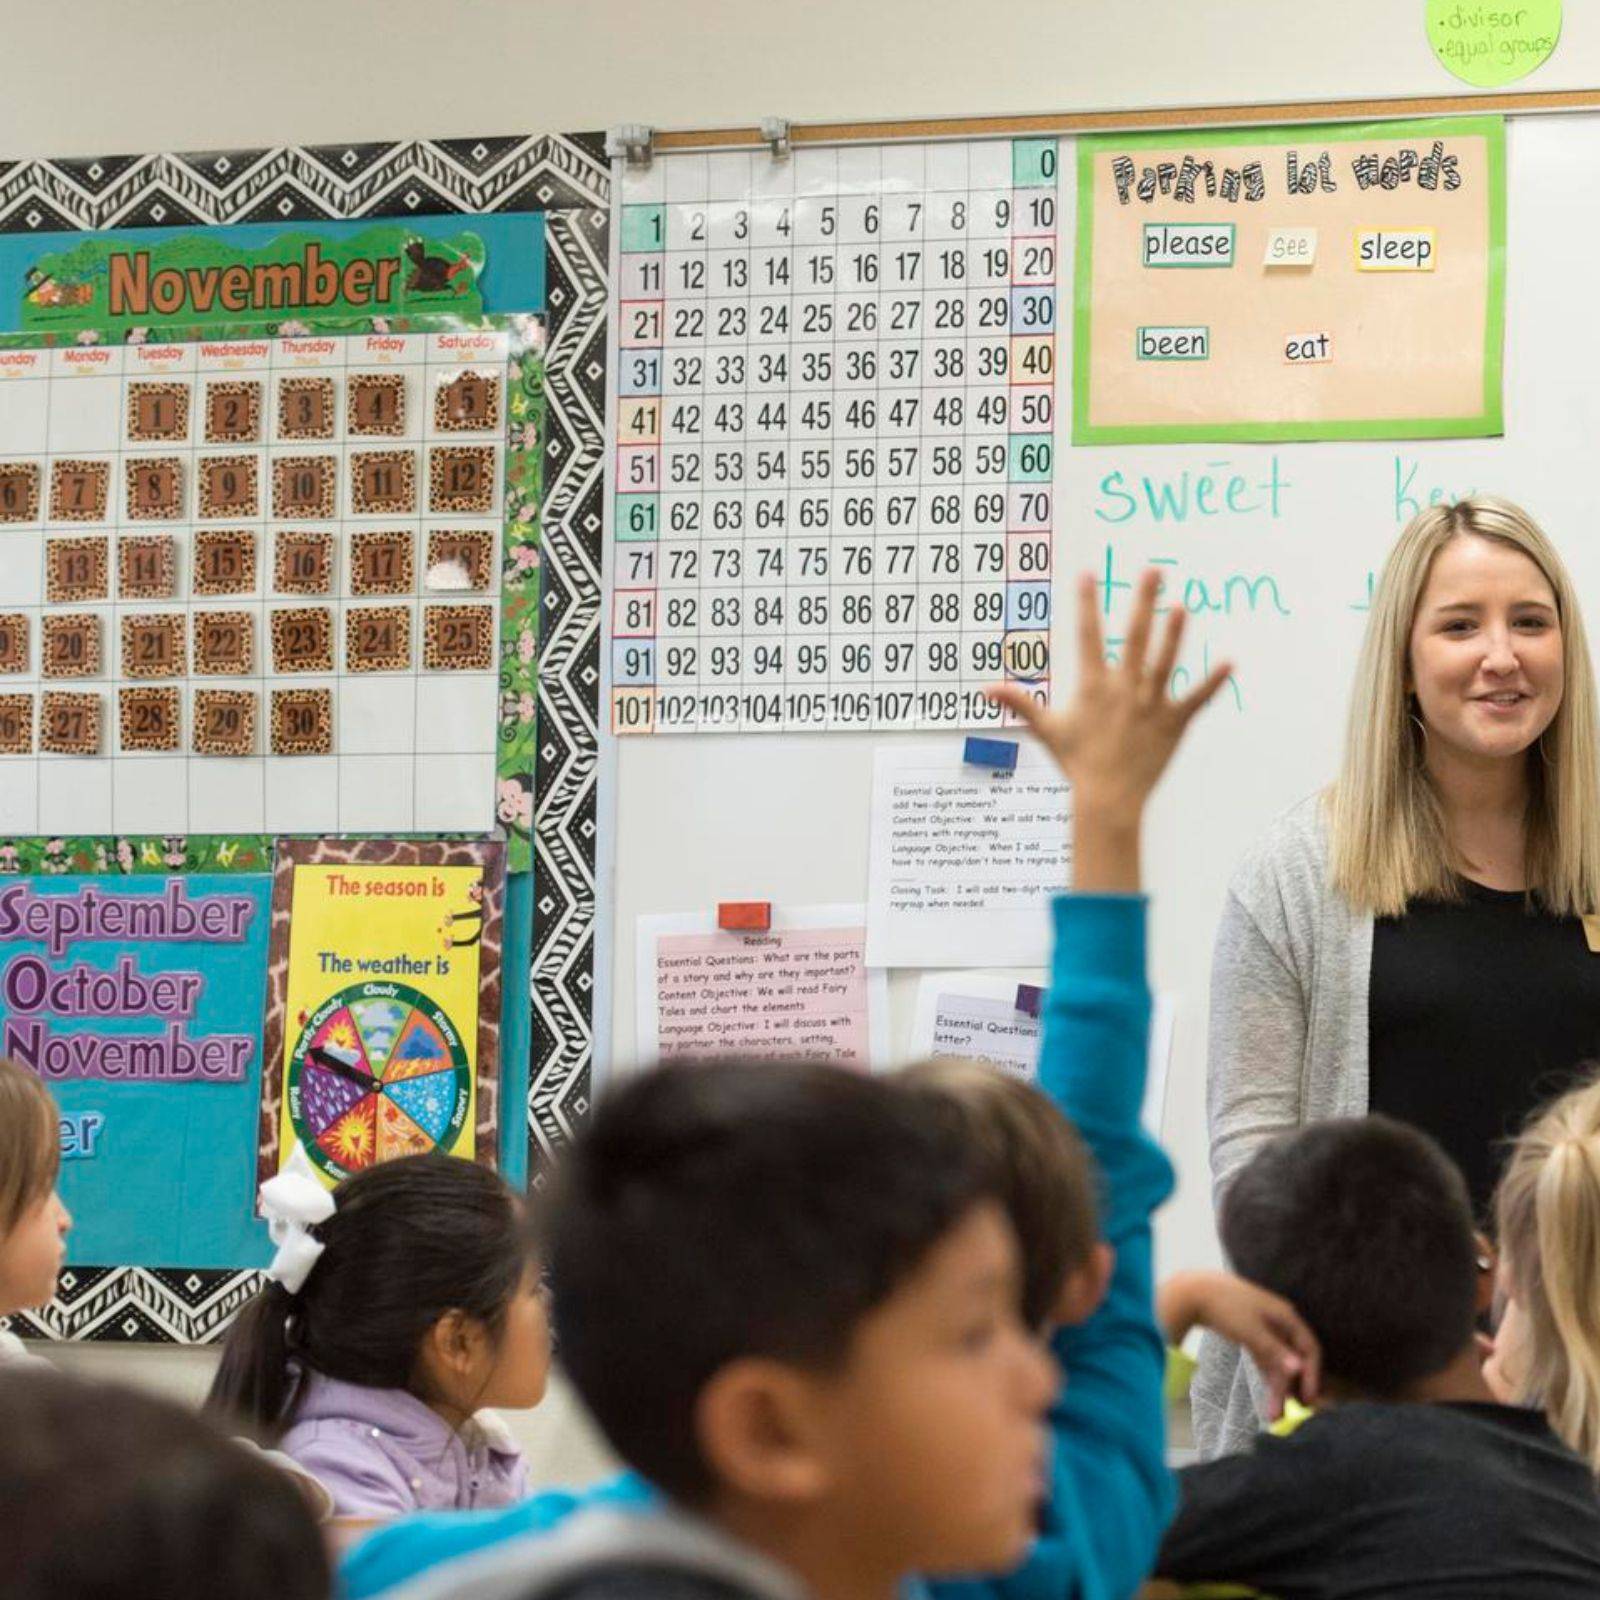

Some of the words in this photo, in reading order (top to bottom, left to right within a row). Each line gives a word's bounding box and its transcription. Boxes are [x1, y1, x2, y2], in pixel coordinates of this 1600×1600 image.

[1450, 5, 1527, 29] divisor
[1446, 32, 1494, 64] equal
[1500, 37, 1552, 64] groups
[1286, 151, 1336, 194] lot
[1352, 141, 1462, 191] words
[1146, 228, 1230, 262] please
[1272, 235, 1308, 258] see
[1360, 233, 1431, 267] sleep
[109, 244, 402, 315] November
[64, 350, 109, 363] Monday
[138, 347, 184, 361] Tuesday
[201, 343, 268, 358] Wednesday
[282, 340, 335, 354] Thursday
[367, 338, 405, 352] Friday
[438, 335, 495, 349] Saturday
[1142, 328, 1206, 356] been
[1285, 333, 1330, 360] eat
[631, 455, 654, 483] 51
[671, 454, 700, 482] 52
[715, 452, 743, 481] 53
[757, 451, 786, 480] 54
[801, 450, 830, 479] 55
[846, 449, 875, 477] 56
[889, 448, 918, 476] 57
[933, 447, 962, 475] 58
[976, 445, 1006, 474] 59
[1021, 444, 1050, 473] 60
[56, 633, 82, 659] 20
[140, 633, 165, 659] 21
[209, 630, 236, 657] 22
[287, 626, 316, 653] 23
[363, 625, 393, 653] 24
[443, 623, 473, 652] 25
[326, 874, 360, 895] The
[365, 881, 427, 897] season
[432, 876, 445, 897] is
[0, 885, 249, 952] September
[743, 936, 782, 947] Reading
[318, 953, 352, 973] The
[357, 953, 431, 974] weather
[437, 955, 449, 975] is
[658, 957, 701, 968] Essential
[763, 953, 790, 962] What
[794, 953, 810, 961] are
[815, 952, 830, 960] the
[834, 951, 859, 964] parts
[6, 958, 198, 1011] October
[363, 984, 399, 997] Cloudy
[657, 974, 668, 983] of
[683, 974, 709, 985] story
[713, 972, 731, 981] and
[735, 972, 753, 982] why
[758, 971, 773, 979] are
[779, 970, 800, 979] they
[315, 998, 342, 1026] Cloudy
[936, 1015, 983, 1031] Essential
[432, 1011, 457, 1047] Stormy
[934, 1033, 972, 1046] letter?
[8, 1024, 249, 1076] November
[290, 1087, 300, 1119] Rainy
[452, 1088, 468, 1127] Snowy
